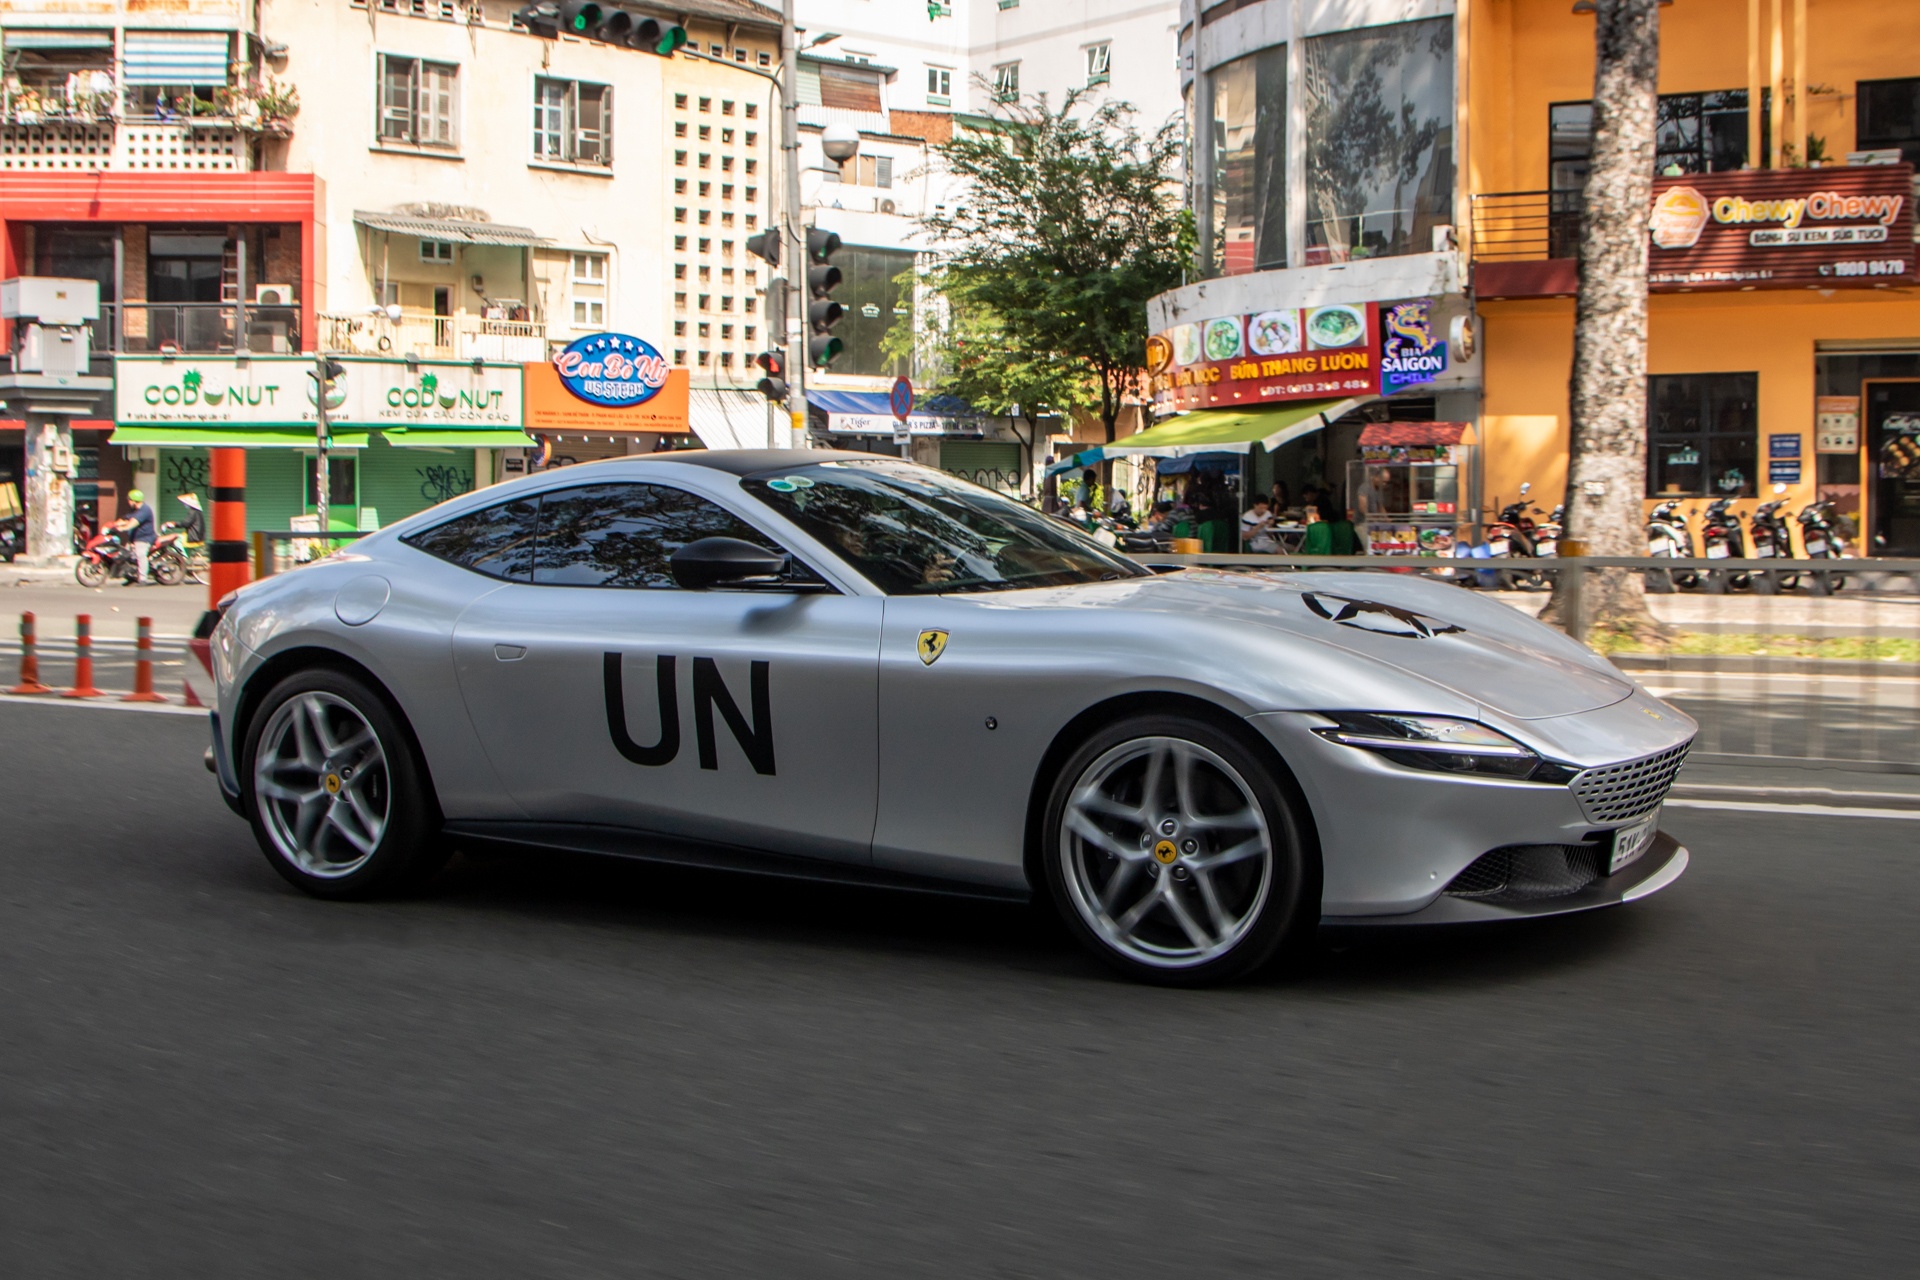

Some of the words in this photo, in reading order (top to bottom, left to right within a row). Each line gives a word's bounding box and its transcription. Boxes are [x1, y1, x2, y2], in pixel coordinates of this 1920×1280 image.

[1713, 196, 1805, 228] Chewy
[1807, 191, 1903, 226] Chewy
[552, 351, 604, 379] Con
[603, 352, 634, 380] Bò
[1230, 360, 1259, 380] BÚN
[1261, 356, 1318, 378] THANG
[1381, 355, 1442, 373] SAIGON
[1389, 372, 1436, 385] CHILL
[584, 380, 602, 397] US
[603, 381, 645, 400] STEAK
[850, 416, 871, 429] Tiger
[919, 421, 936, 430] PIZZA
[603, 651, 777, 776] UN
